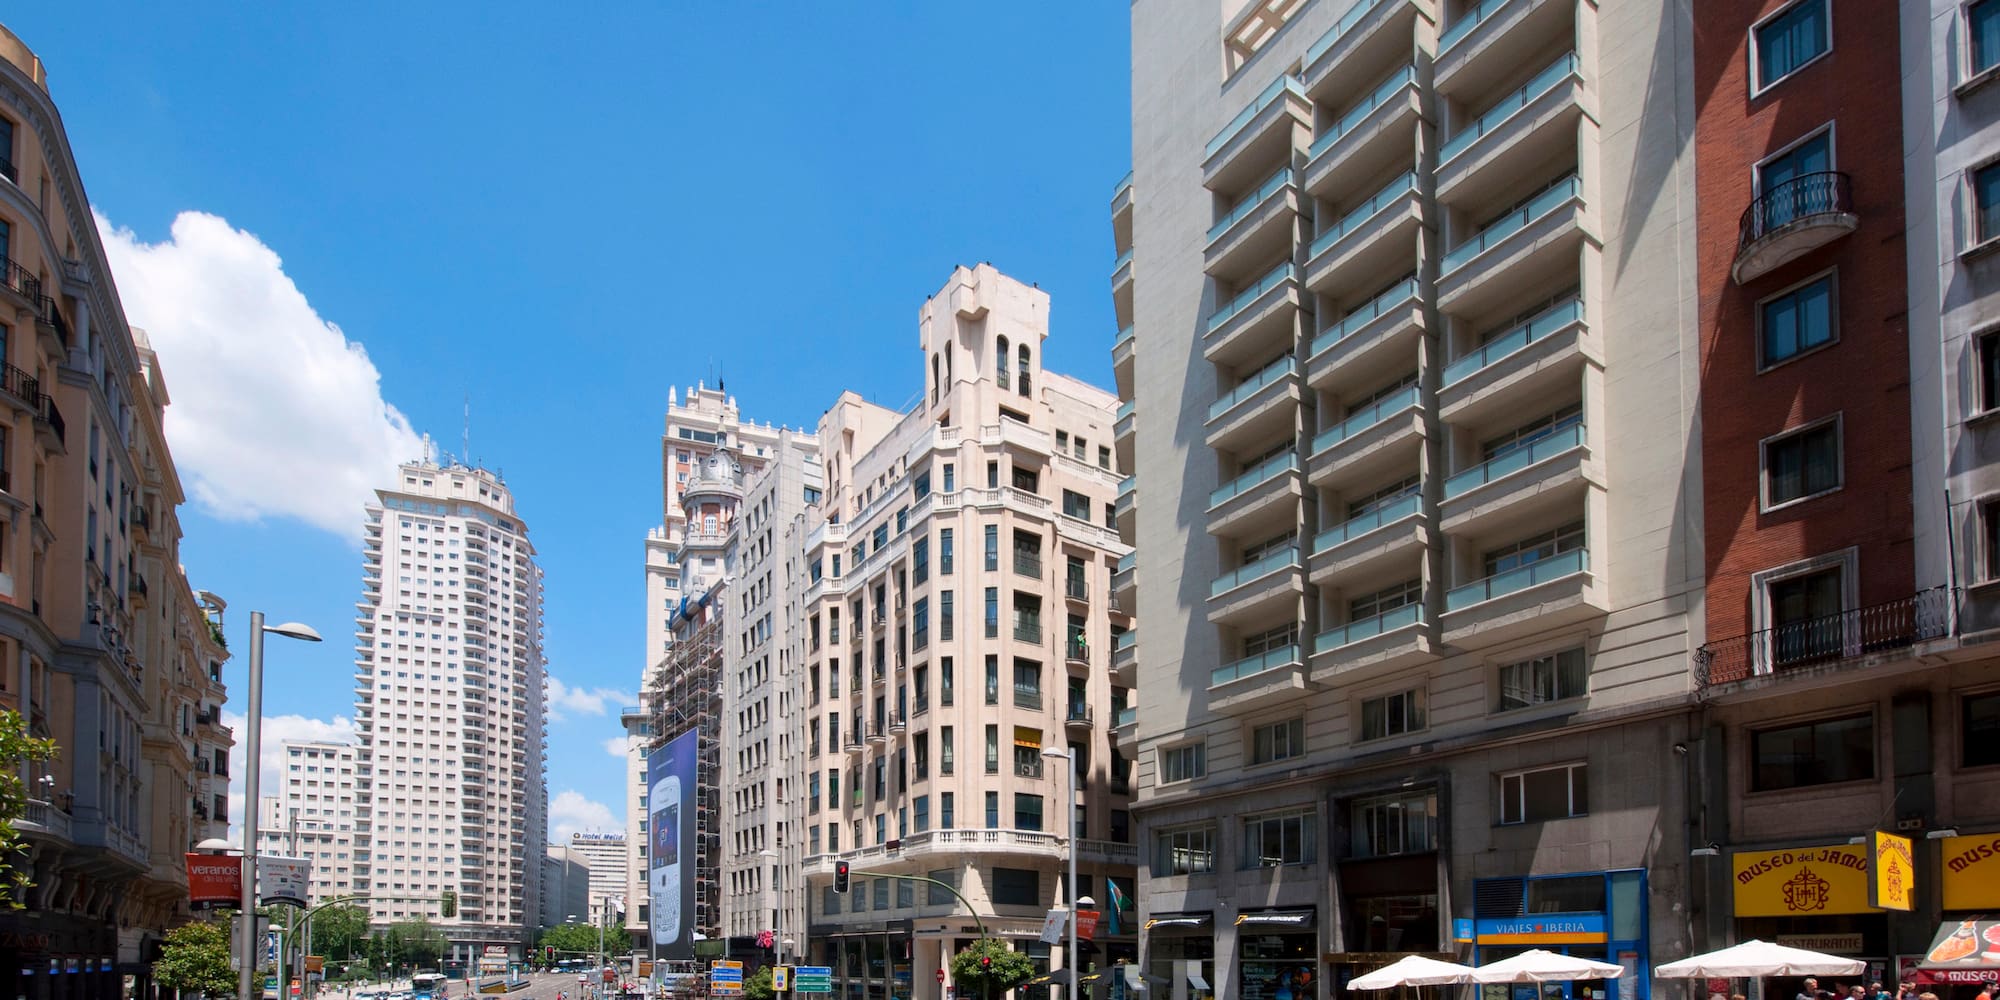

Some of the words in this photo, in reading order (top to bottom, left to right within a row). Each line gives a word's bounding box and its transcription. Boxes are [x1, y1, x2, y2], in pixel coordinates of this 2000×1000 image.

[191, 865, 239, 876] veranos
[1737, 852, 1794, 885] MUSEO
[1797, 852, 1814, 862] del
[1817, 850, 1869, 873] JAMO
[1496, 923, 1533, 935] VIAJES
[1545, 922, 1585, 933] IBERIA
[1779, 937, 1861, 949] RESTAURANTE
[1948, 970, 1998, 982] MUSEO
